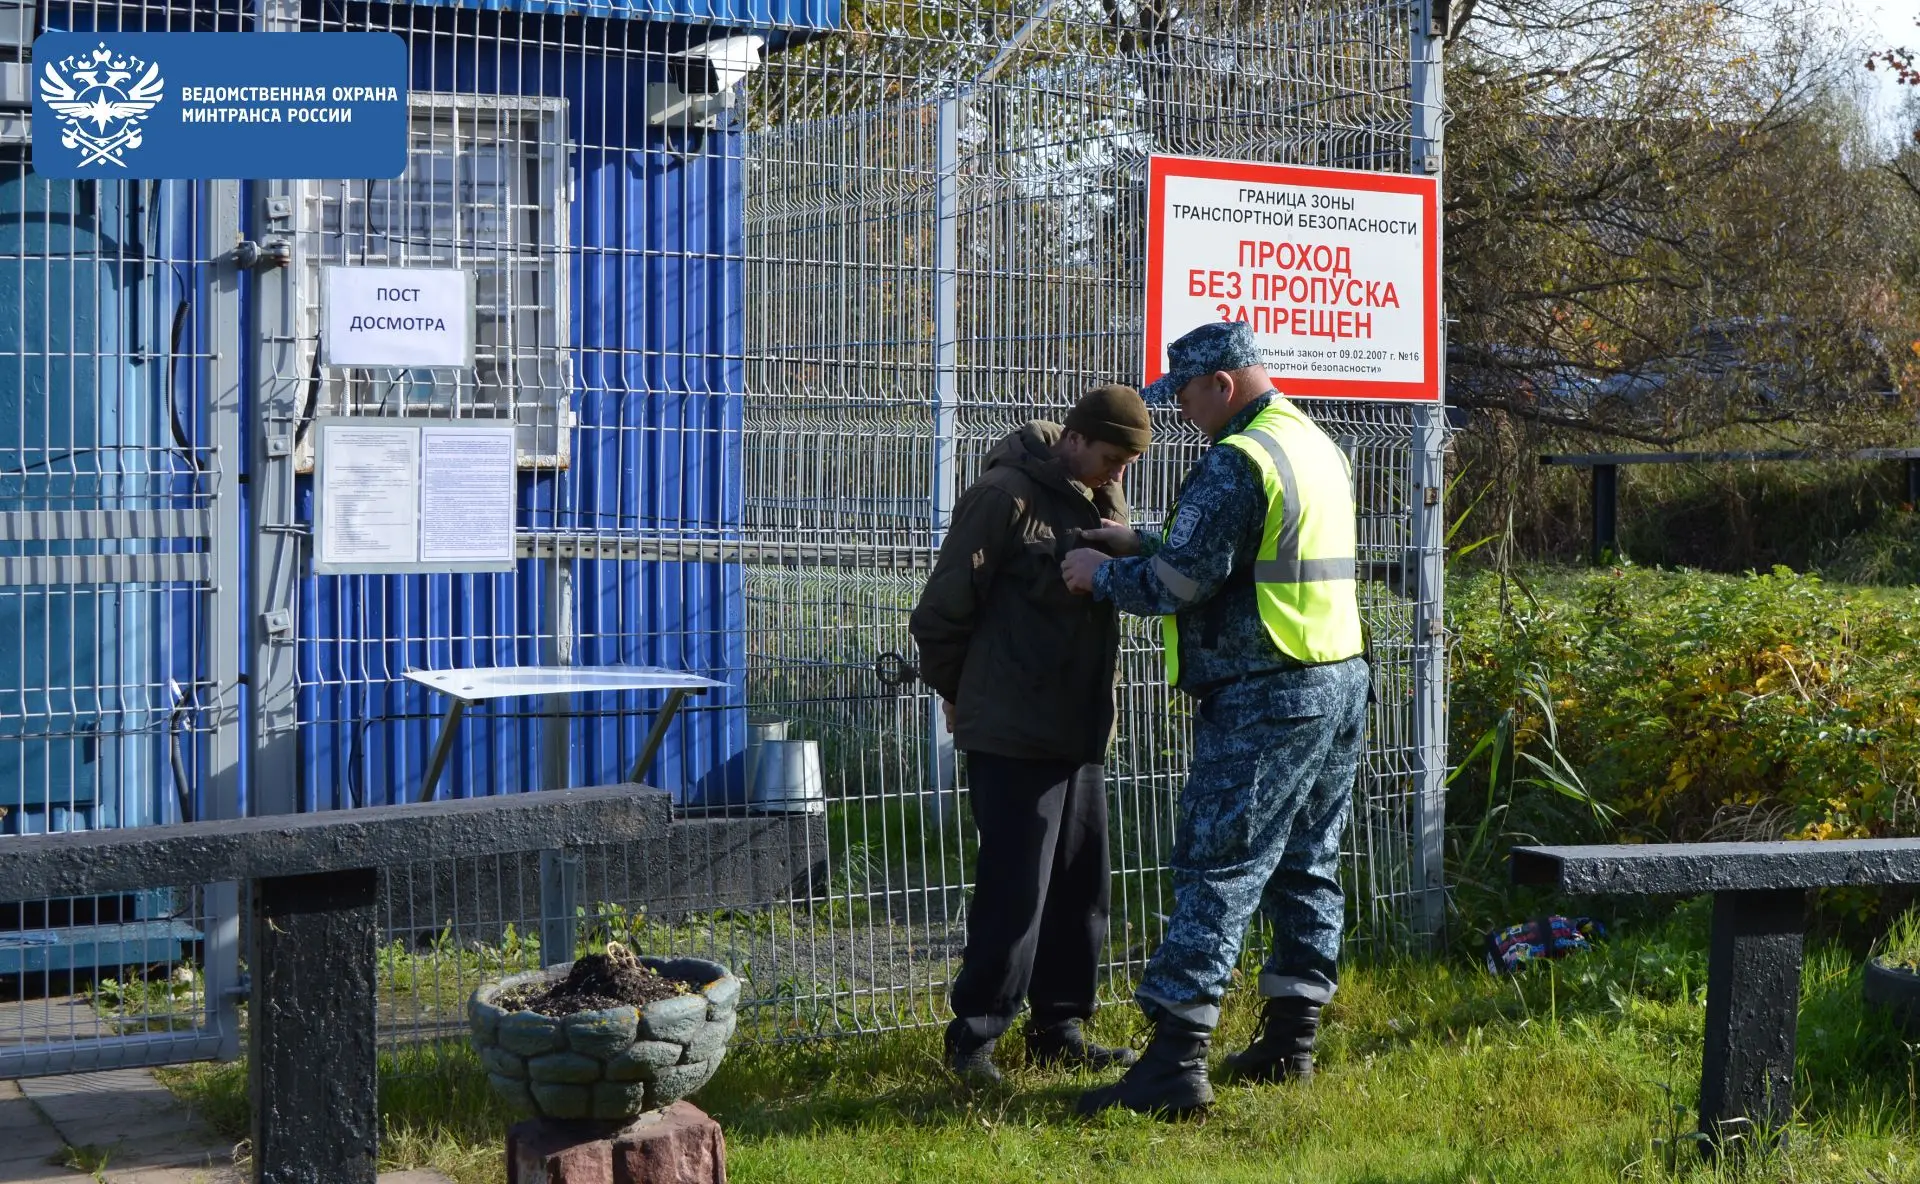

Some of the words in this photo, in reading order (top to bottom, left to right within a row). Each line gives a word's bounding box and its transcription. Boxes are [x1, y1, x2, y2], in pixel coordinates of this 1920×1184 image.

[1239, 188, 1307, 209] ГРАНИЦА
[1311, 194, 1355, 211] ЗОНЫ
[1172, 204, 1294, 227] ТРАНСПОРТНОЙ
[1298, 213, 1417, 236] БЕЗОПАСНОСТИ
[1238, 240, 1352, 279] ПРОХОД
[377, 287, 420, 302] ПОСТ
[1189, 269, 1242, 300] БЕЗ
[1251, 273, 1400, 309] ПРОПУСКА
[349, 315, 446, 333] ДОСМОТРА
[1297, 348, 1324, 358] закон
[1326, 351, 1337, 359] от
[1339, 349, 1387, 360] 09.02.2007
[1390, 353, 1396, 361] г.
[1398, 351, 1420, 361] №16
[1262, 361, 1308, 372] спортной
[1311, 362, 1382, 373] безопасности»
